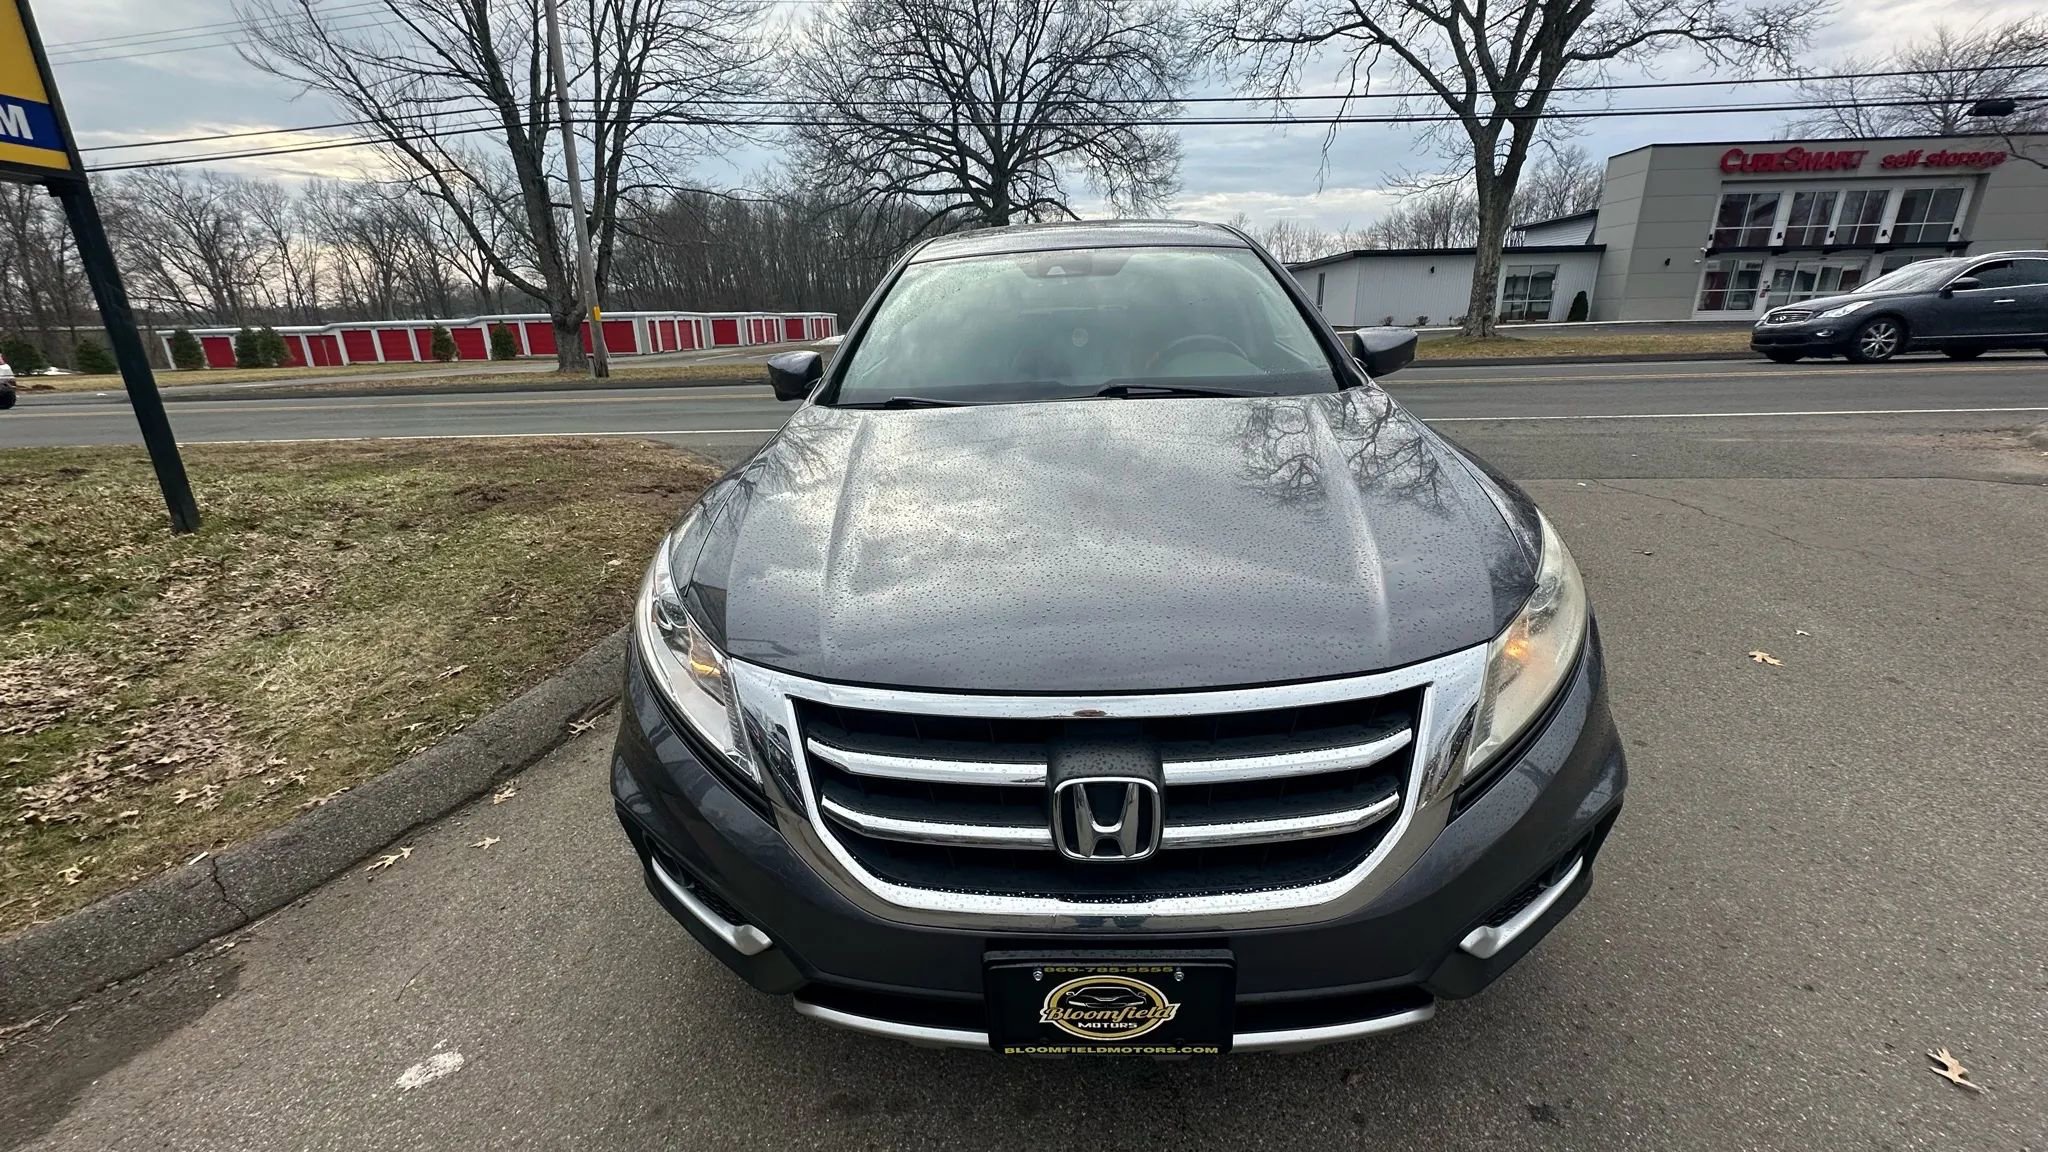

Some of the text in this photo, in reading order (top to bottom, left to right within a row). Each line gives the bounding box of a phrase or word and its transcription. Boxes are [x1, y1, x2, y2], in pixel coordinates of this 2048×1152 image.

[1880, 149, 1924, 169] self
[1925, 149, 2007, 169] storage
[1046, 1005, 1174, 1022] Bloomfield
